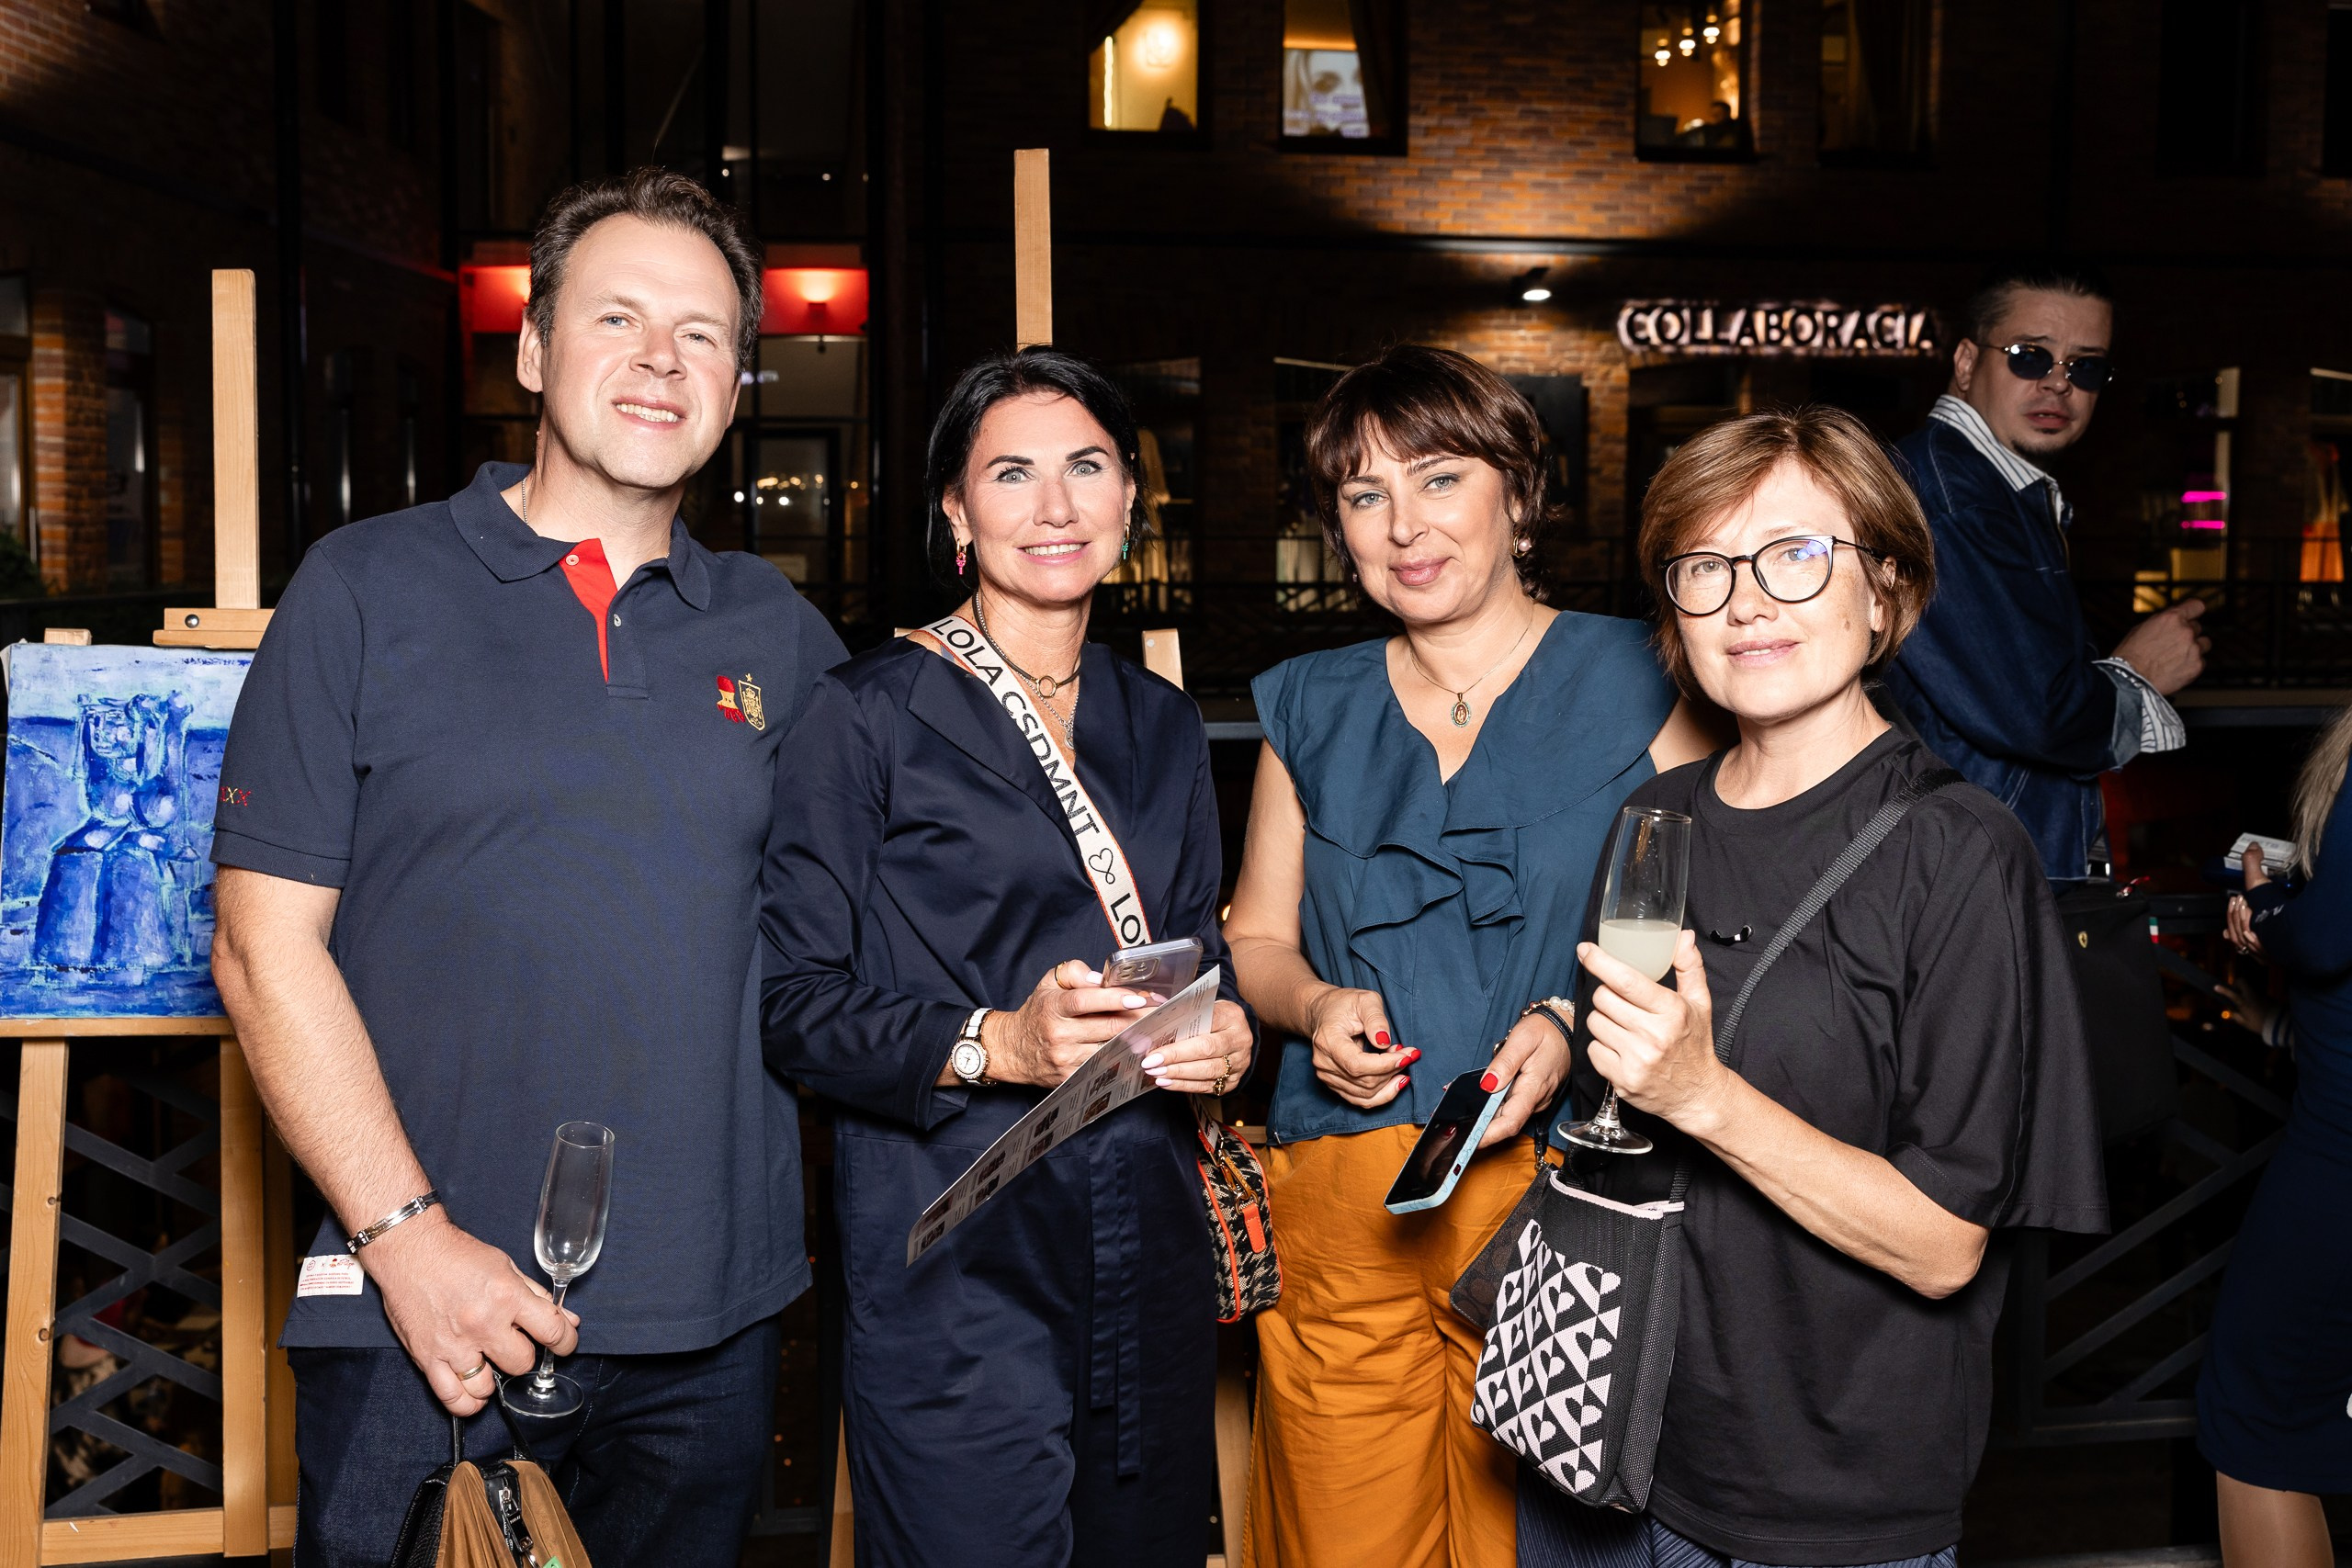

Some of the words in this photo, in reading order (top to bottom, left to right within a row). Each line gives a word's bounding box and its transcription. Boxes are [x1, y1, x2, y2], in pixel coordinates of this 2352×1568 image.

[1624, 304, 1940, 349] COLLABORACIA
[931, 619, 1003, 686] LOLA
[1001, 691, 1100, 836] CSDMNT
[1110, 892, 1146, 947] LO
